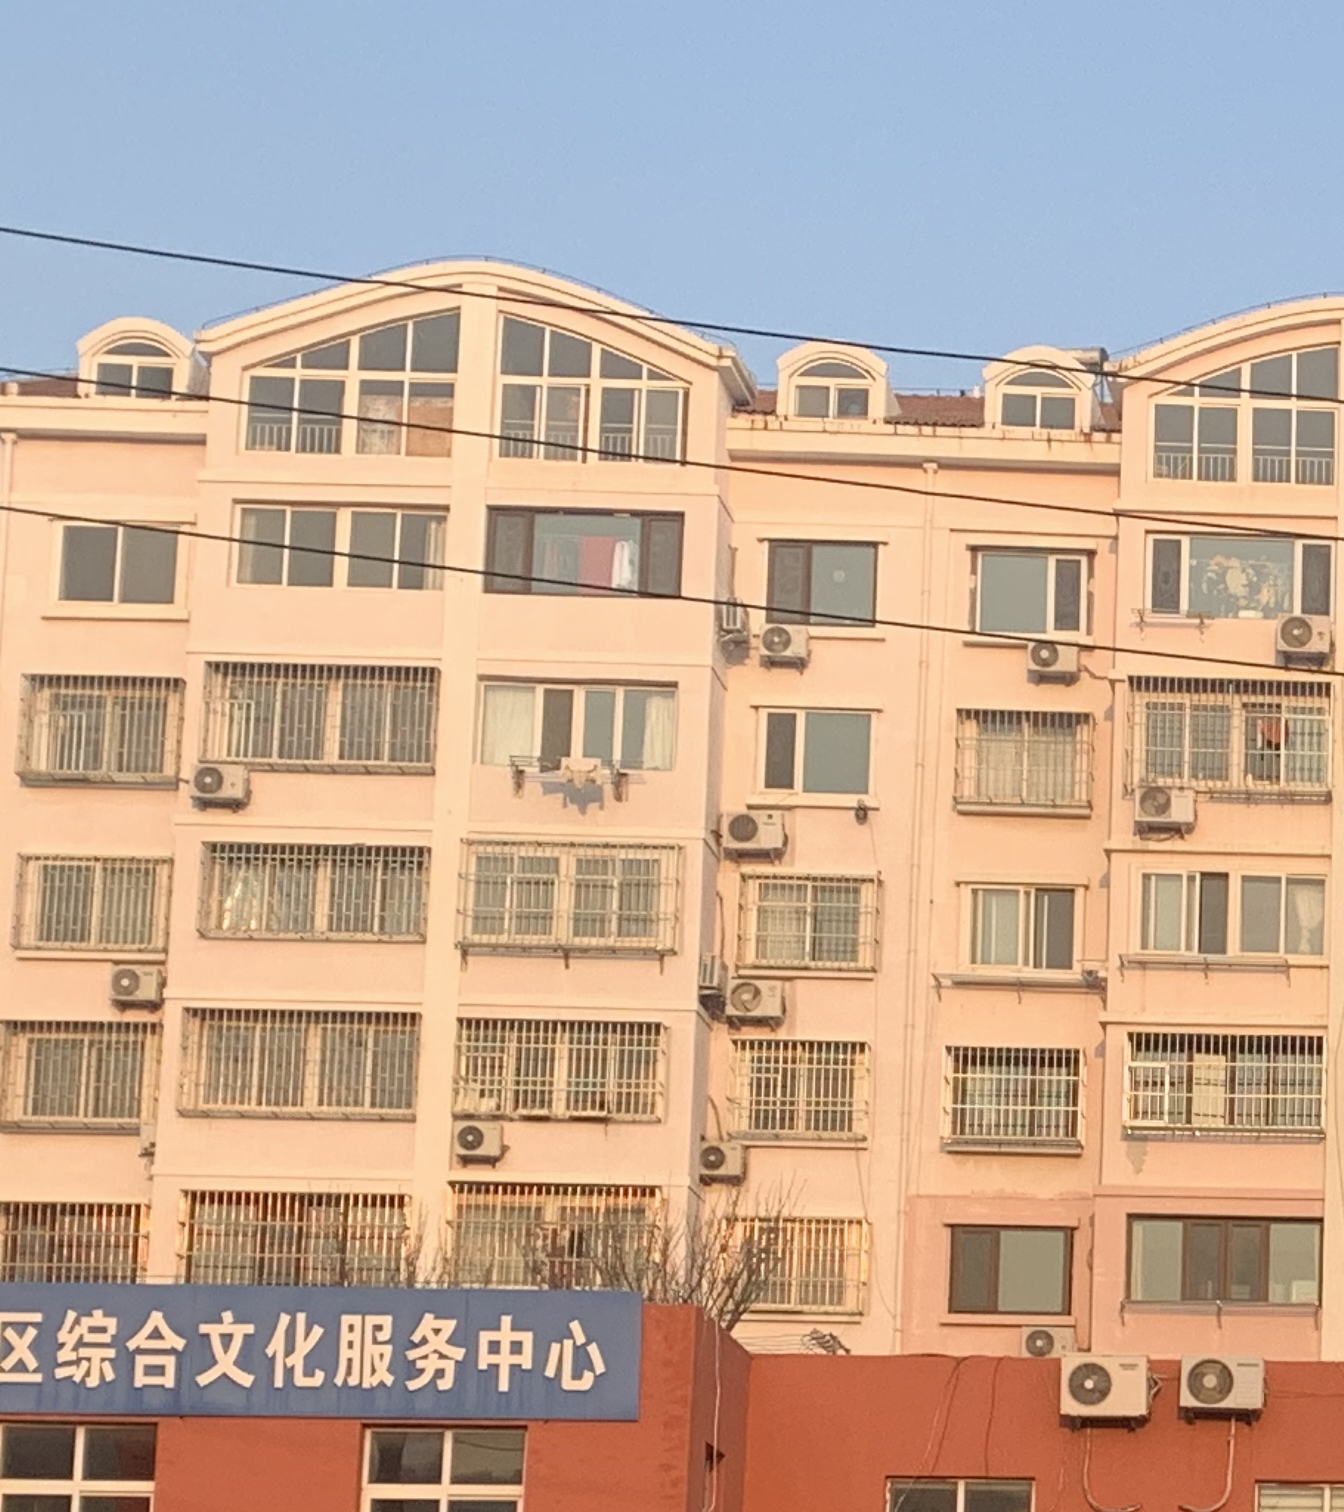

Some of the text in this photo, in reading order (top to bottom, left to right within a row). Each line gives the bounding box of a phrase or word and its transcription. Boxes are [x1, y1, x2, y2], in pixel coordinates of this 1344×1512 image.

[0, 1310, 606, 1393] 区综合文化服务中心
